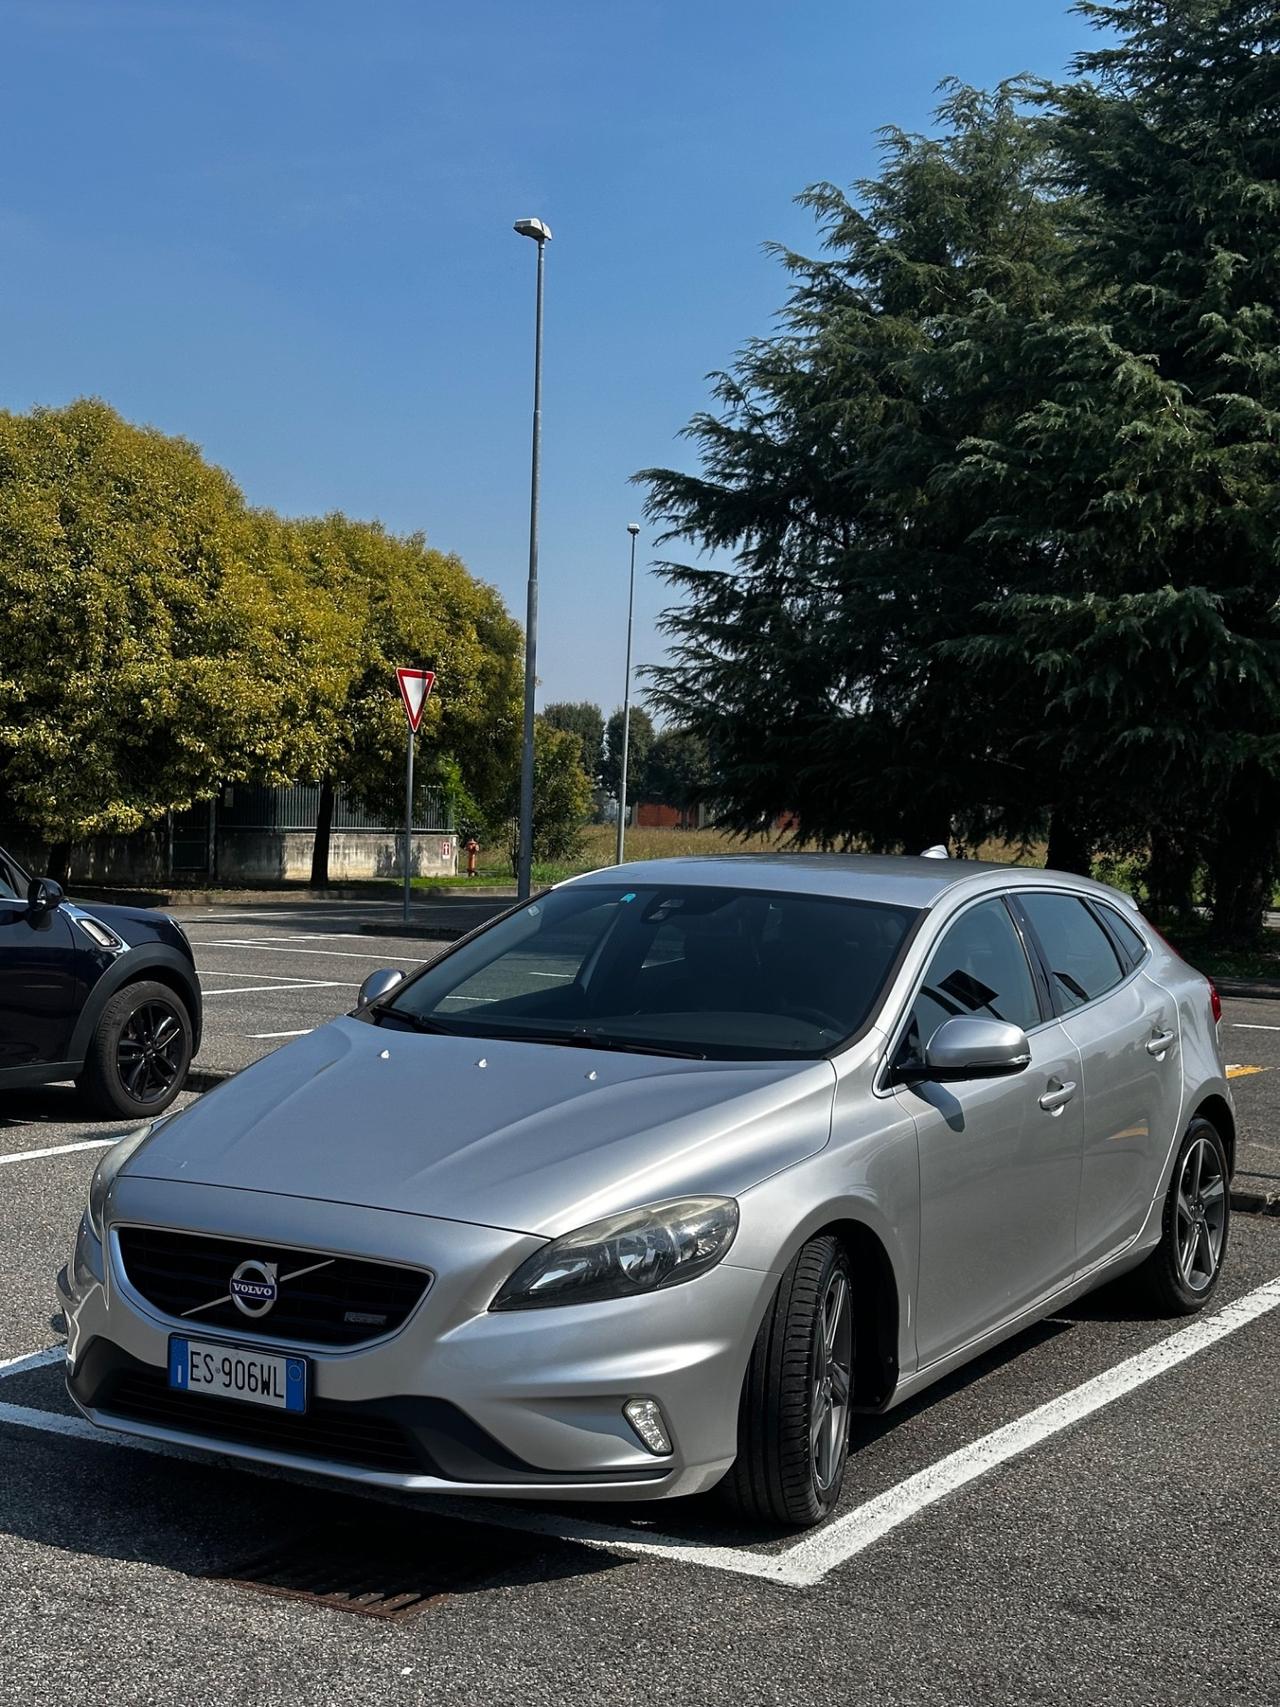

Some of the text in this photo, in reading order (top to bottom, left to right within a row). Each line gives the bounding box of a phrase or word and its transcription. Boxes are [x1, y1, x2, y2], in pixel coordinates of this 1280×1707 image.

[232, 1282, 272, 1296] VOLVO
[190, 1350, 285, 1399] ES 906WL
